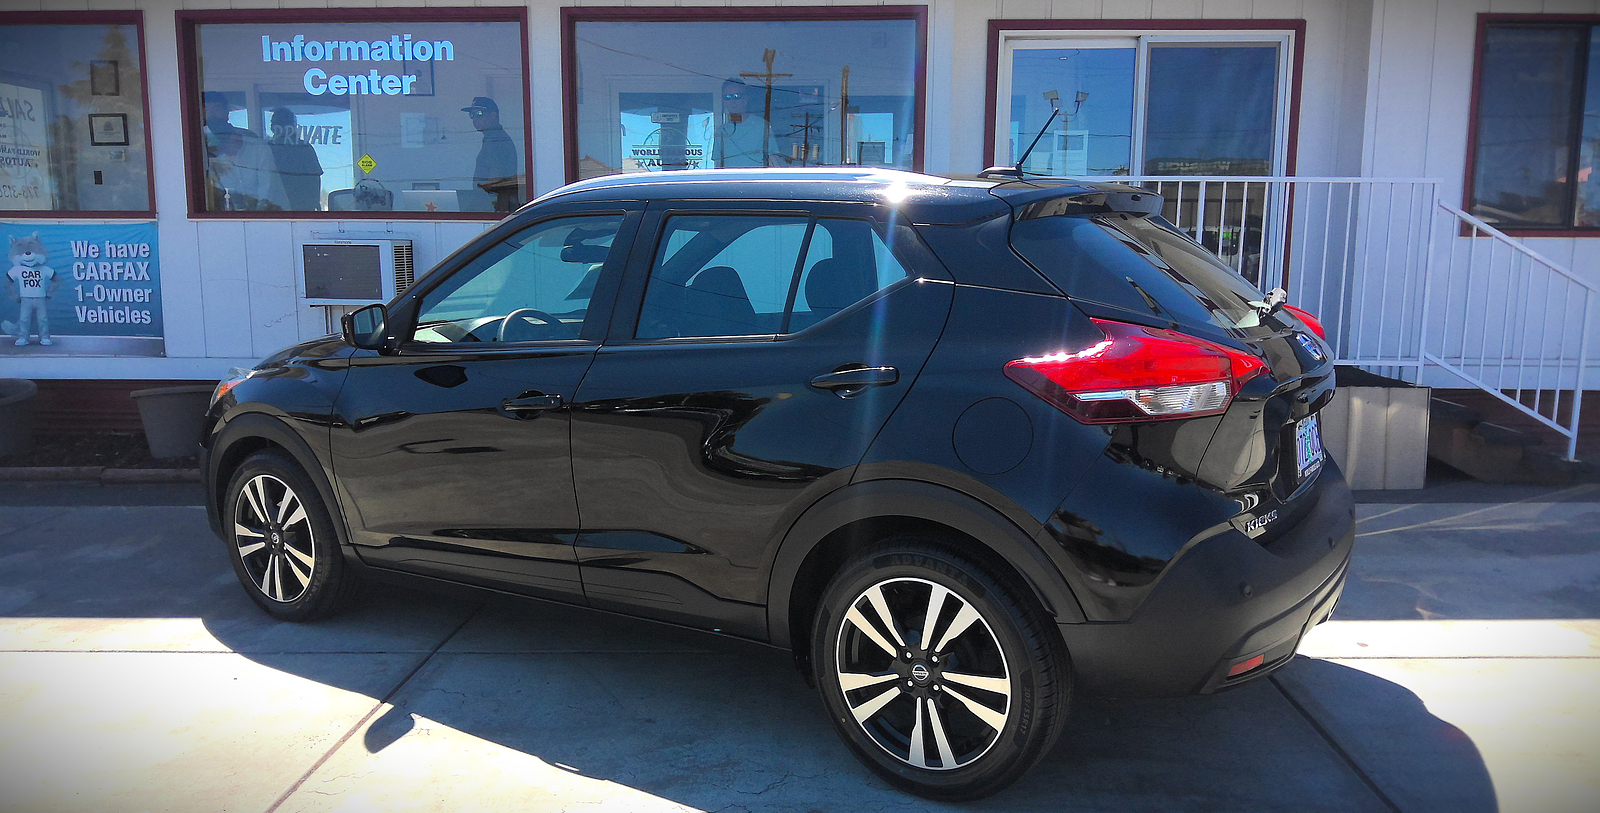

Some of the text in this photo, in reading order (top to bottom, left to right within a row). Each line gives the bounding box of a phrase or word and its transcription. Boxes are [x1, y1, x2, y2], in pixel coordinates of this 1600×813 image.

[262, 34, 454, 62] Information
[303, 67, 417, 96] Center
[272, 124, 343, 145] PRIVATE
[647, 158, 689, 167] AUS
[70, 240, 150, 258] We have
[21, 270, 42, 279] CAR
[72, 261, 151, 281] CARFAX
[23, 279, 41, 288] FOX
[75, 284, 153, 303] 1-Owner
[75, 305, 152, 324] Vehicles
[1246, 509, 1278, 533] KICKS
